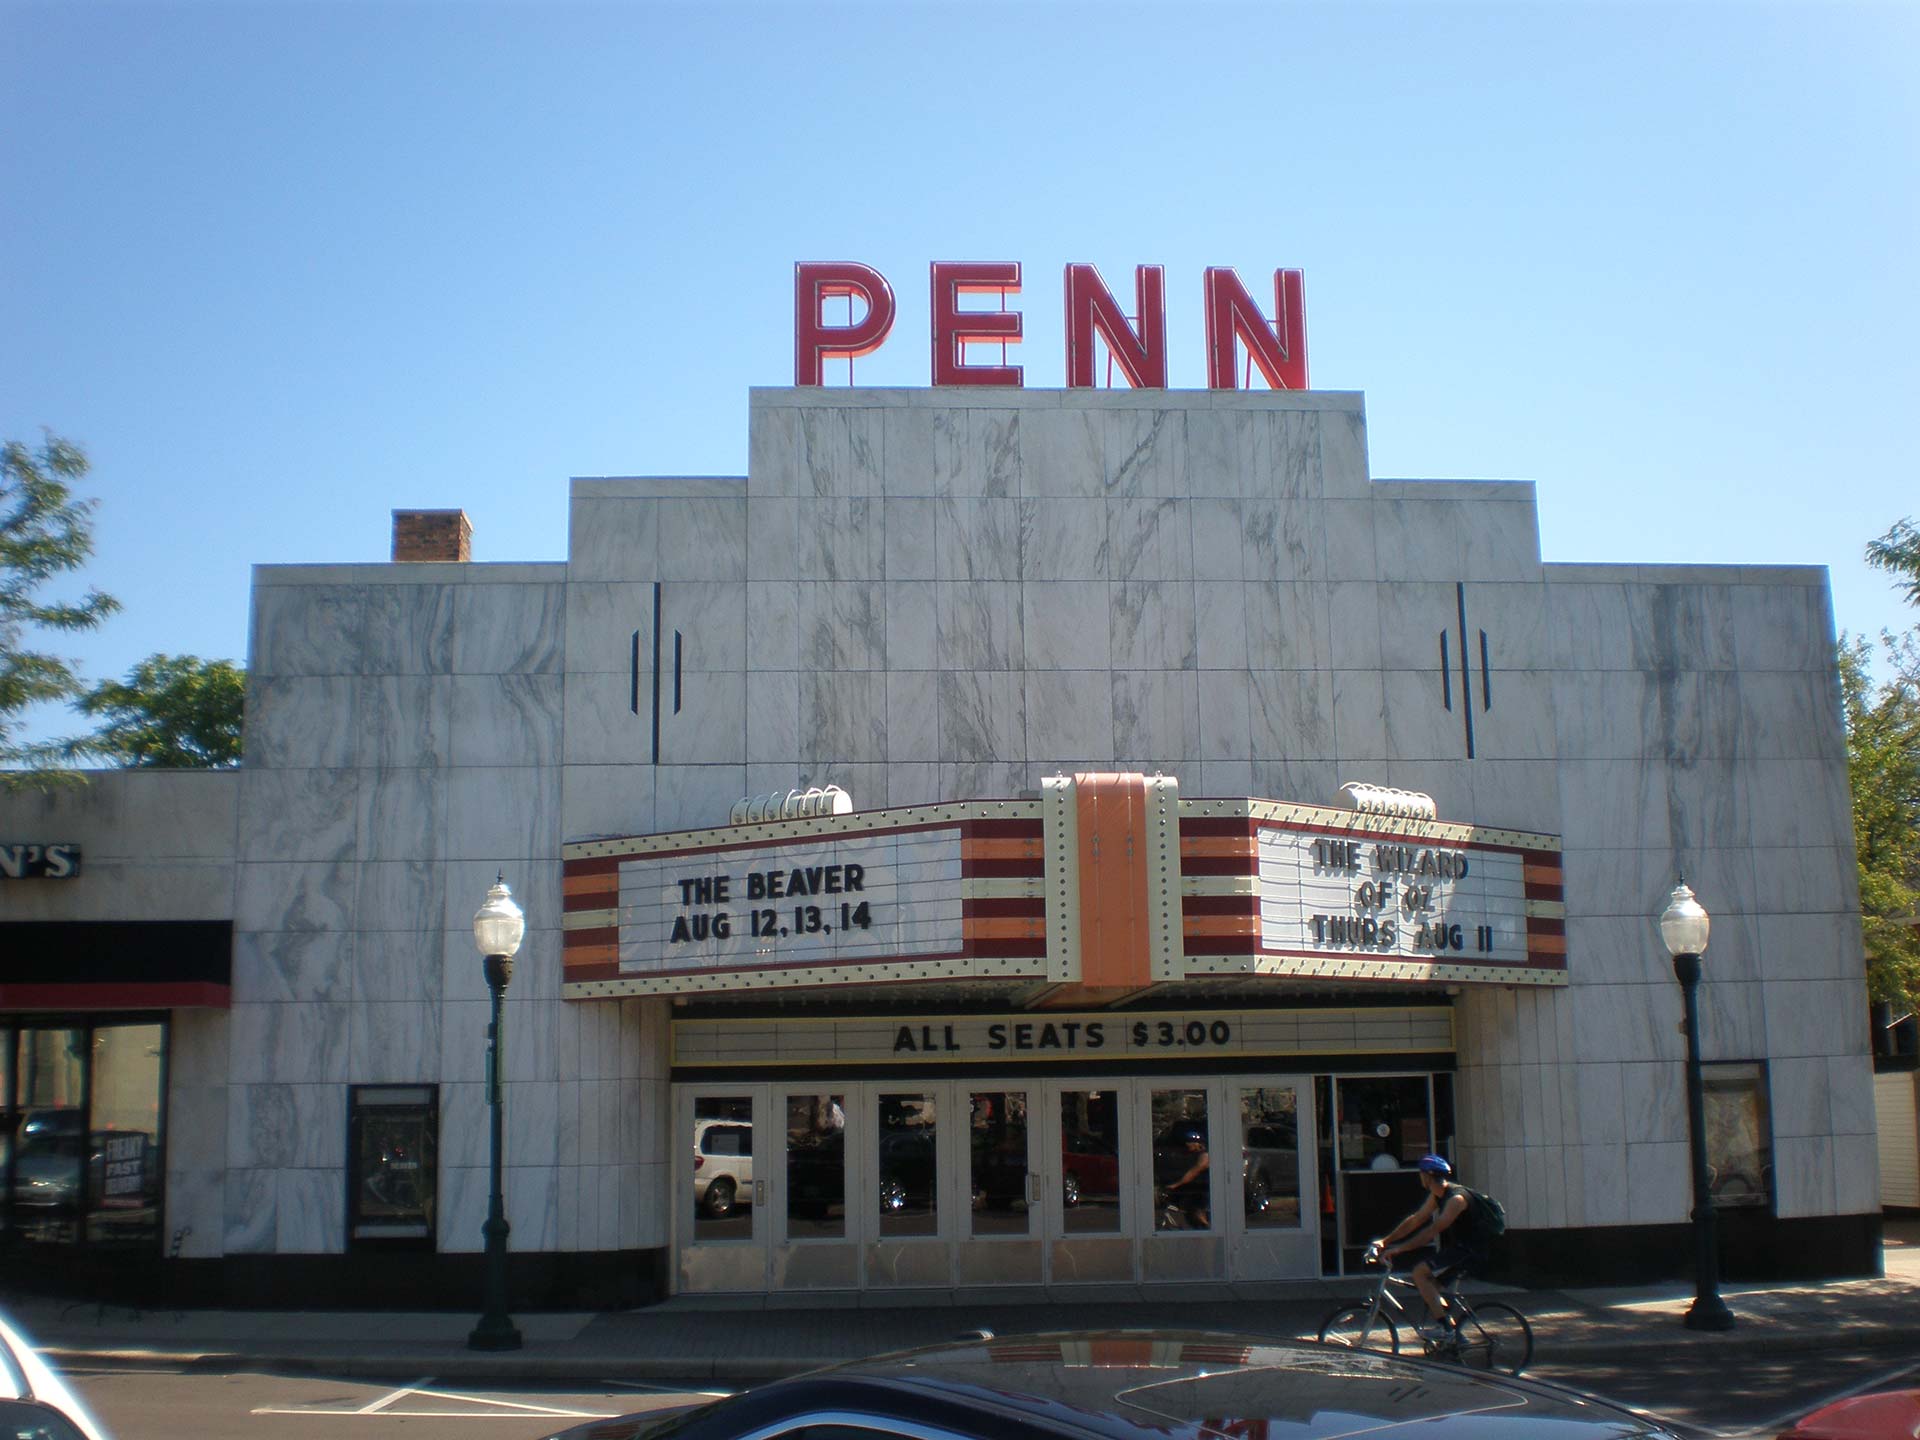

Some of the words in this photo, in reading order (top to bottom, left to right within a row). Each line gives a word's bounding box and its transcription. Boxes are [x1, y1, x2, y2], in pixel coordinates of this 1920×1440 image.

[794, 260, 1310, 390] PENN
[1314, 838, 1361, 872] THE
[1375, 844, 1469, 880] WIZARD
[678, 875, 730, 906] THE
[747, 863, 865, 900] BEAVER
[1360, 880, 1393, 909] OF
[1406, 885, 1436, 913] OZ
[670, 912, 731, 943] AUG
[1313, 914, 1397, 948] THURS
[1417, 921, 1464, 951] AUG
[1478, 925, 1493, 952] 11
[894, 1025, 961, 1052] ALL
[988, 1021, 1105, 1050] SEATS
[1132, 1019, 1231, 1047] $3.00
[106, 1160, 141, 1177] FAST
